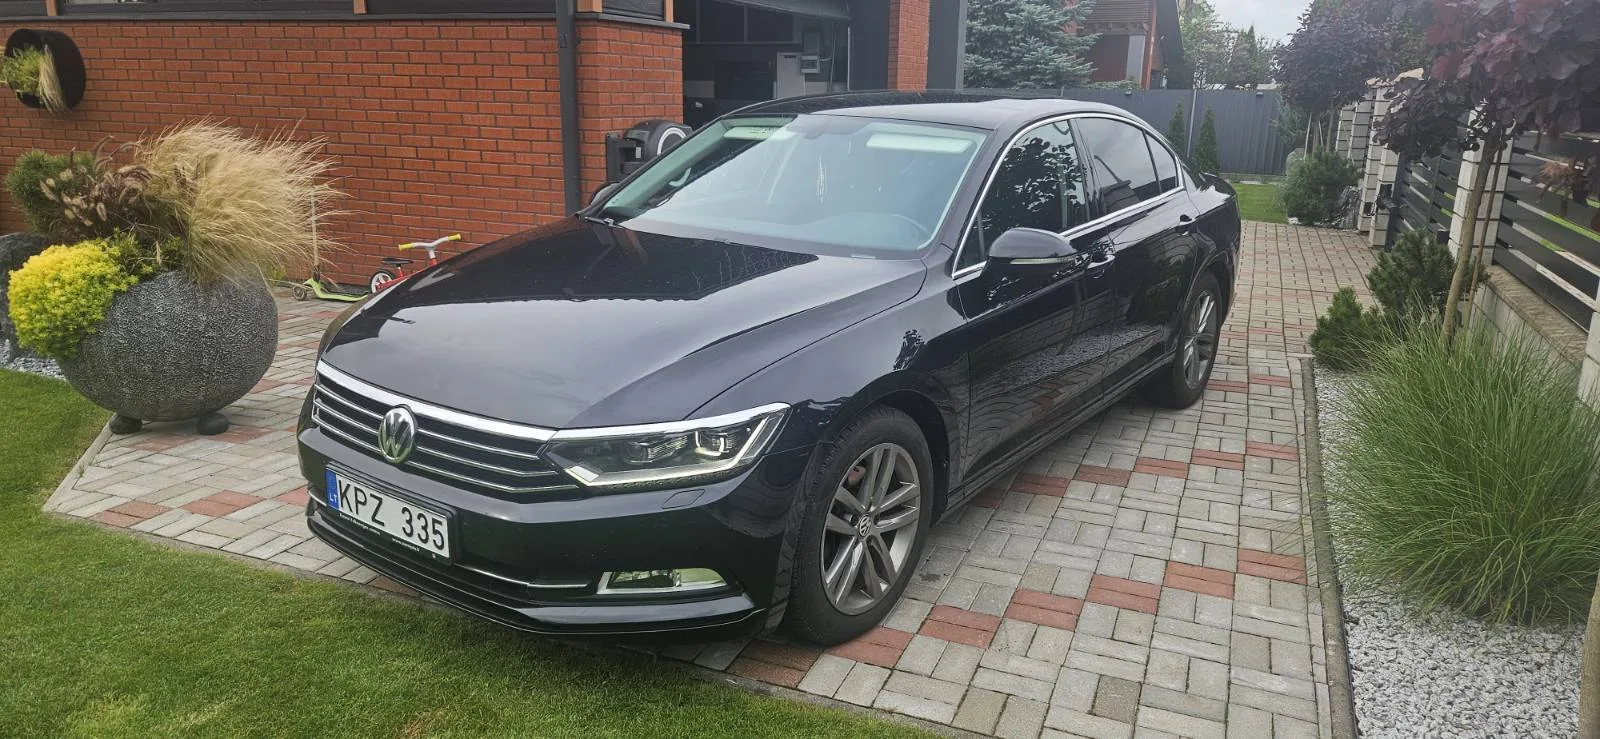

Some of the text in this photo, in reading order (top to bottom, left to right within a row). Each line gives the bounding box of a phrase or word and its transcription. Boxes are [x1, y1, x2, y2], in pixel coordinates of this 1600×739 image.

[329, 493, 338, 503] LT
[338, 479, 385, 527] KPZ
[401, 506, 445, 551] 335
